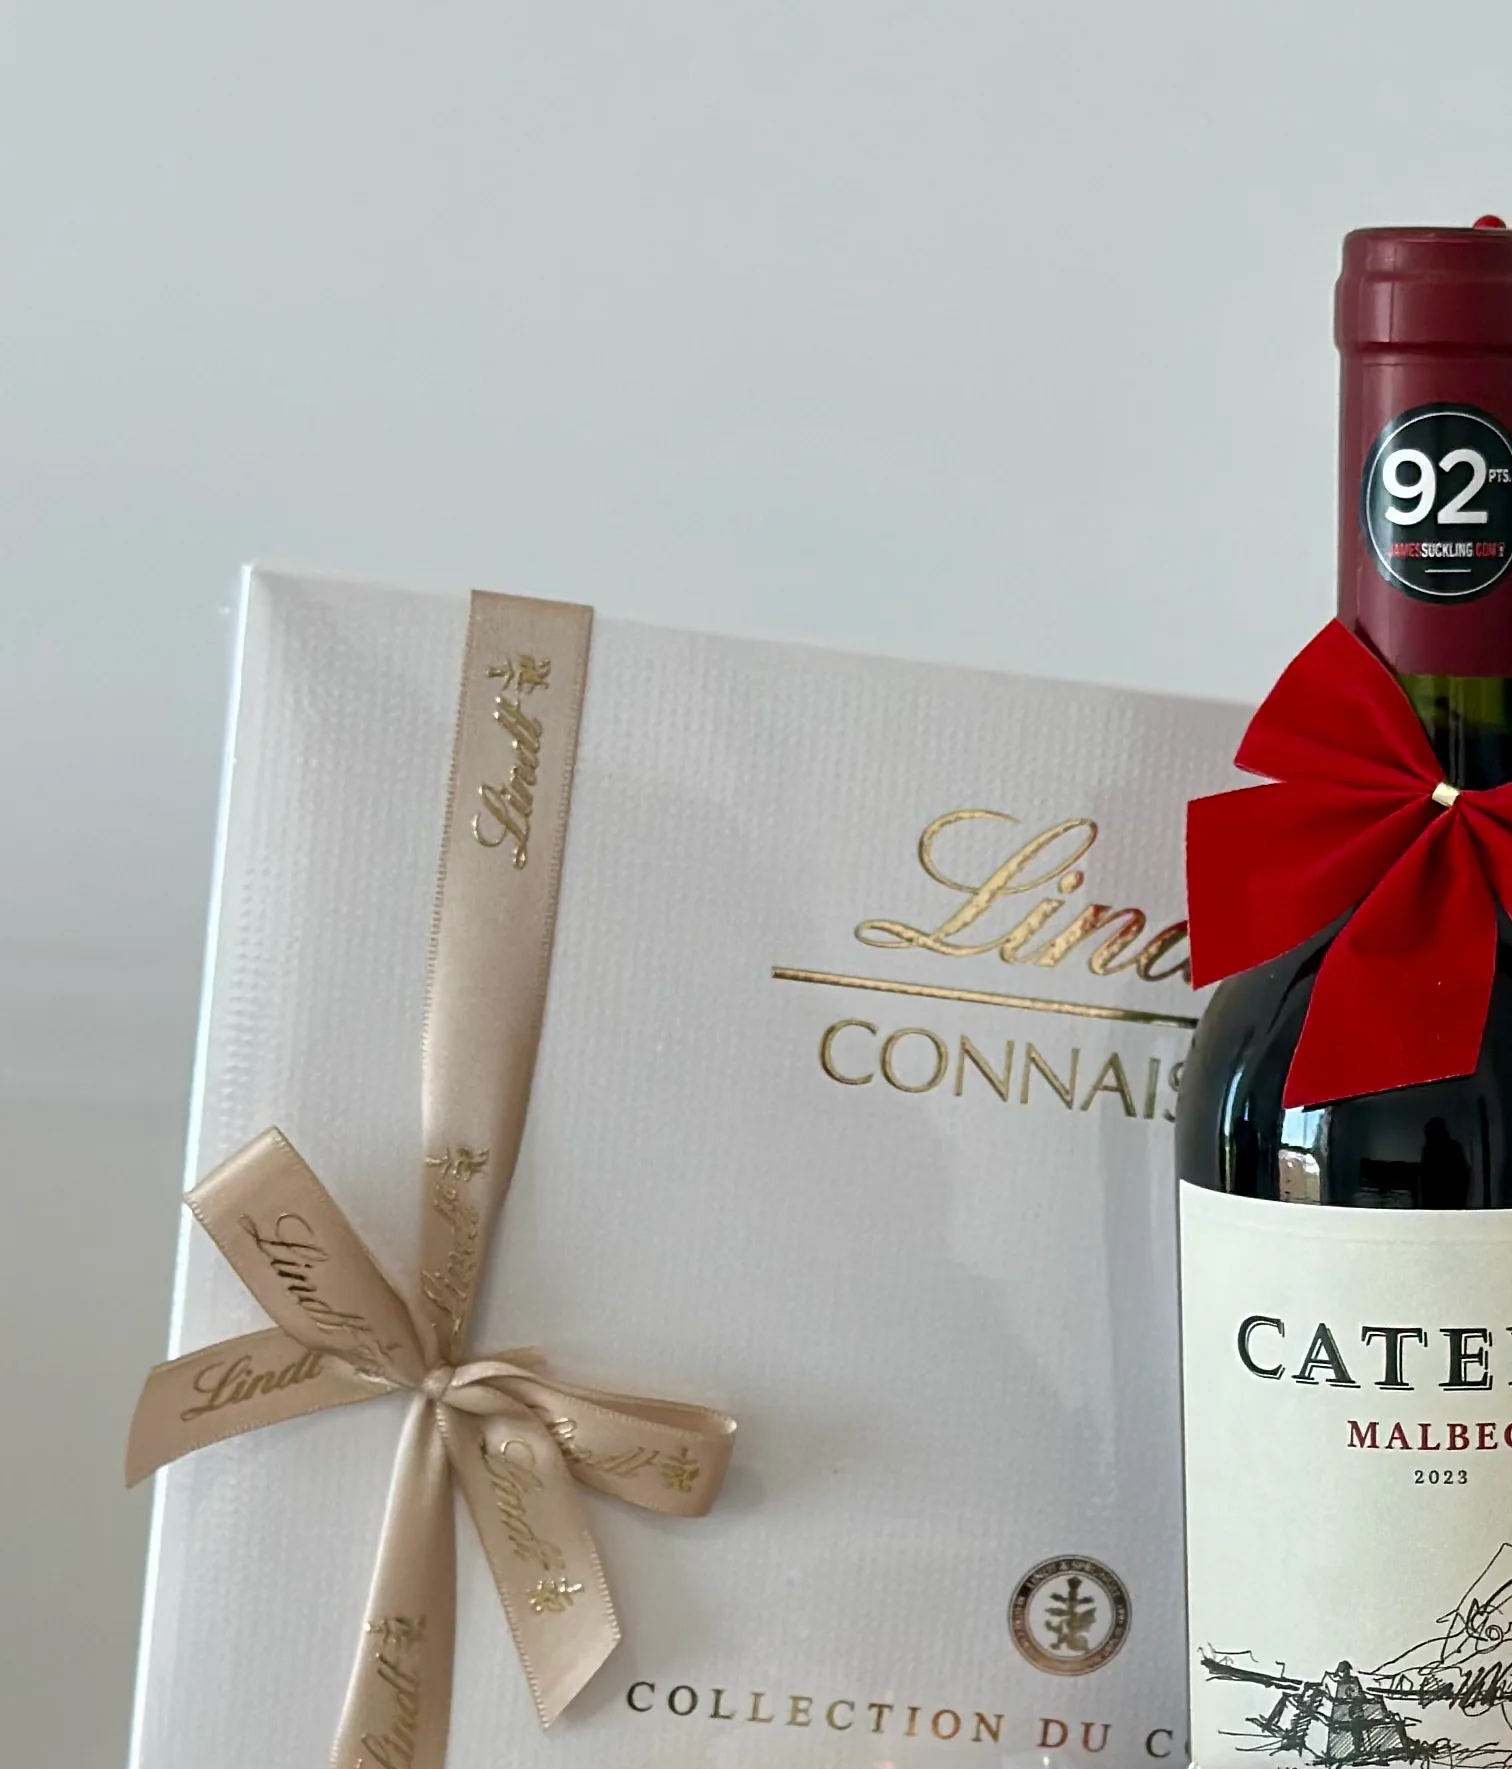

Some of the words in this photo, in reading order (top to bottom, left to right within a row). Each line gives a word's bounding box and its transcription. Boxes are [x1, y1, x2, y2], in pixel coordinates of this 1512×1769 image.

[1382, 447, 1488, 526] 92
[1413, 1469, 1469, 1486] 2023
[626, 1680, 1004, 1744] COLLECTION
[1037, 1717, 1112, 1753] DU
